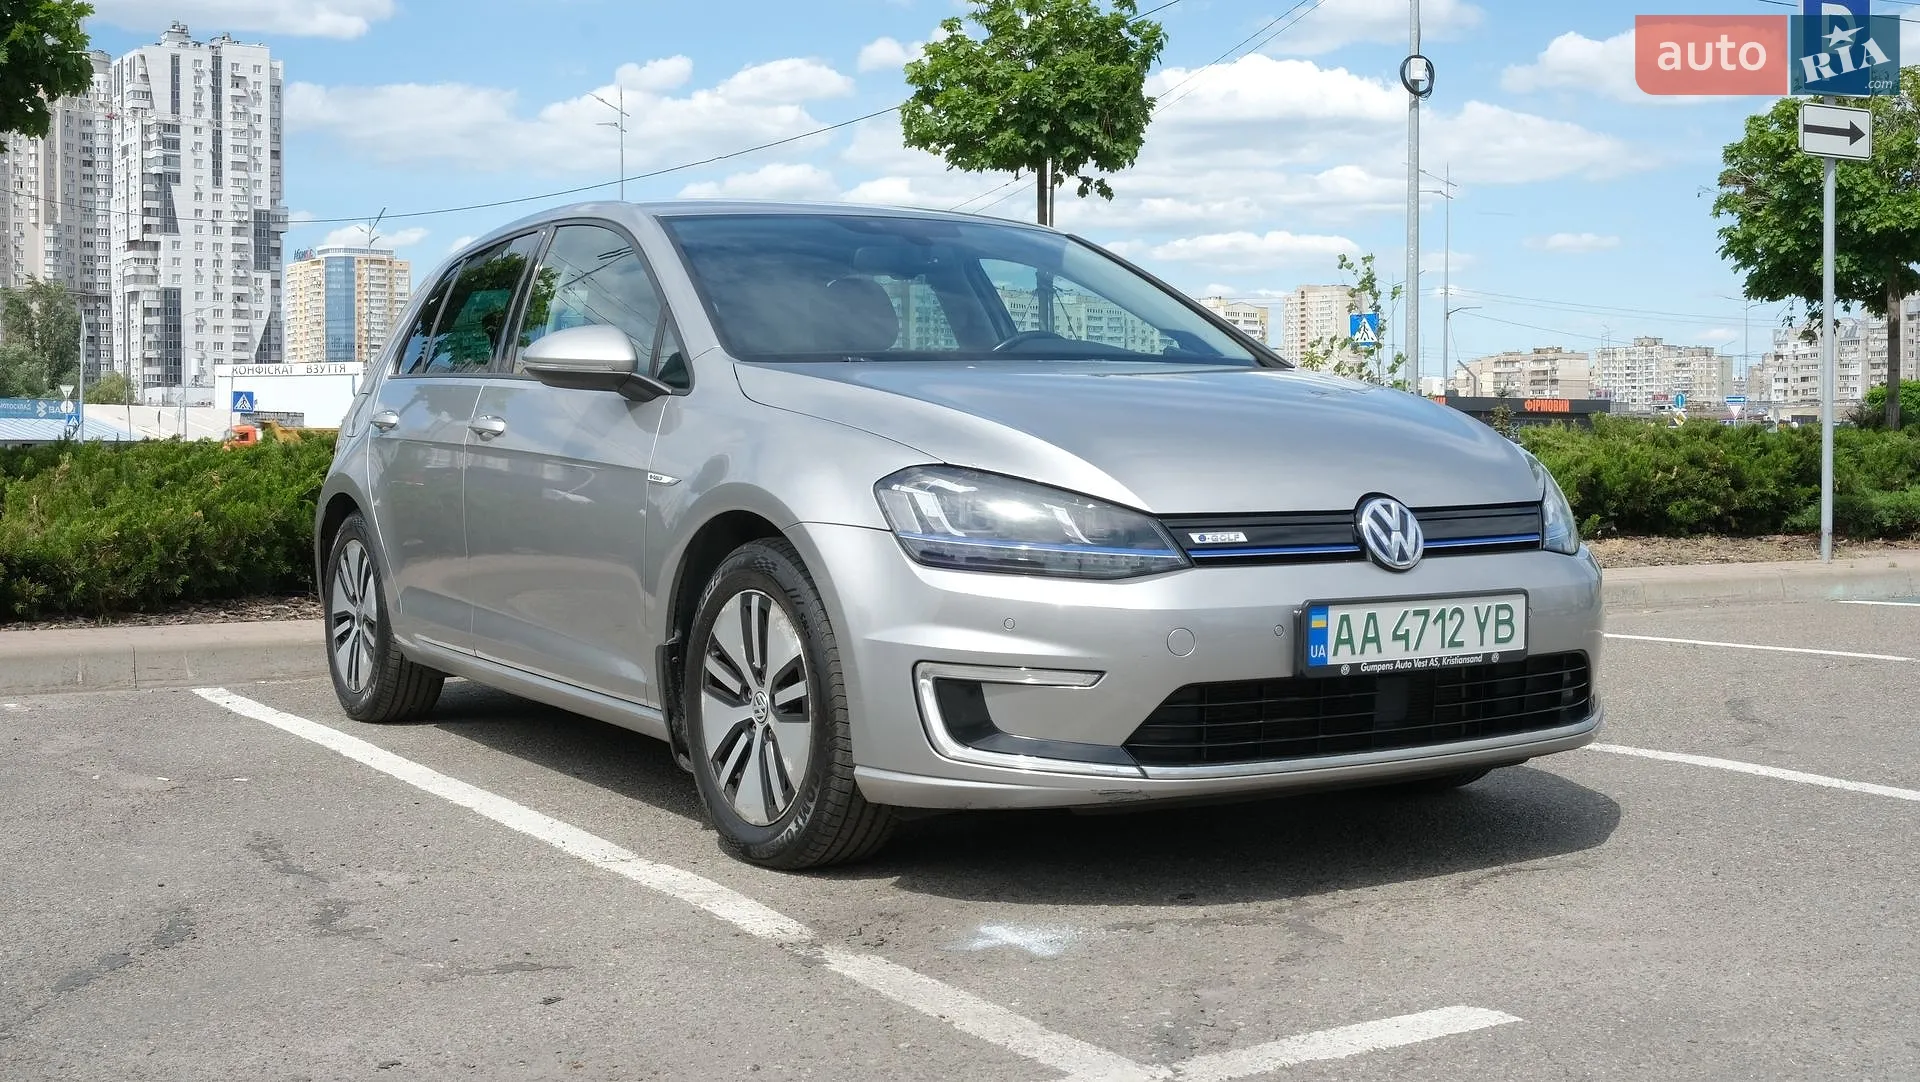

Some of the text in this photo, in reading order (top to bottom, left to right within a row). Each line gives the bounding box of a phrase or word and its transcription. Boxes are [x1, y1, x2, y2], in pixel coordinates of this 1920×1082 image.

[232, 363, 346, 375] КОНФІСКАТ ВЗУТТЯ
[1332, 603, 1516, 657] AA 4712 YB
[1310, 644, 1326, 659] UA
[1360, 662, 1394, 673] Gumpens
[1395, 660, 1412, 670] Auto
[1413, 658, 1428, 669] Vest
[1429, 657, 1440, 668] AS,
[1441, 654, 1483, 666] Kristiansand
